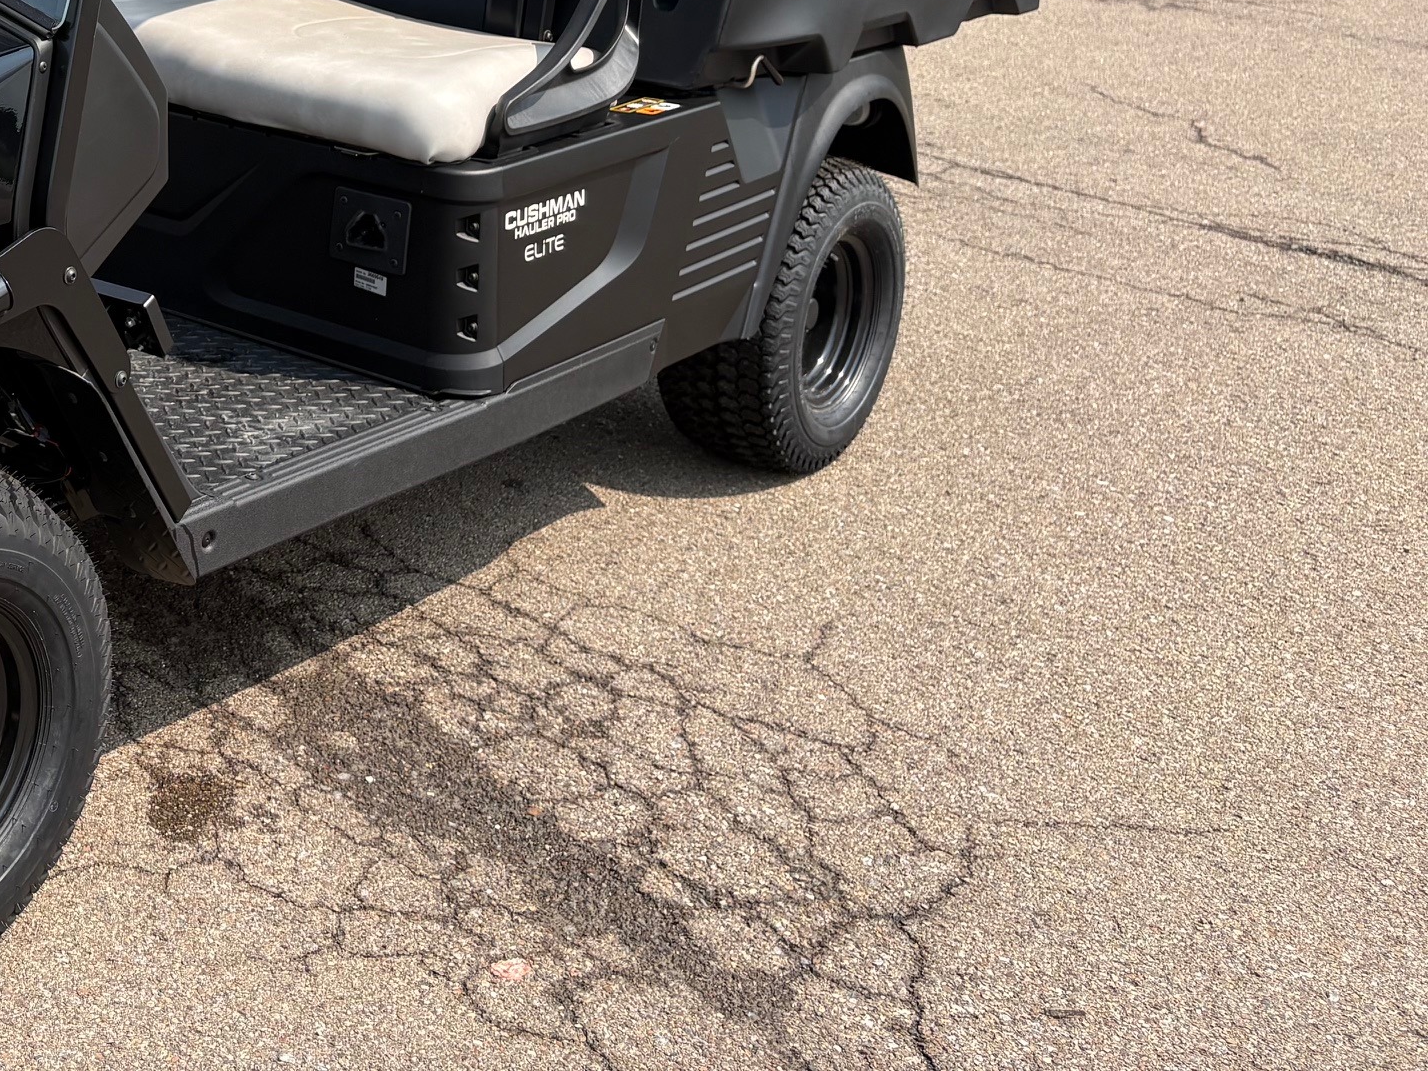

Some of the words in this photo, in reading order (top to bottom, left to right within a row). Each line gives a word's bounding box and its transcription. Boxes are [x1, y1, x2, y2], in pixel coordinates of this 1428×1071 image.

[504, 188, 586, 231] CUSHMAN
[514, 215, 555, 240] HAULER
[556, 209, 576, 226] PRO
